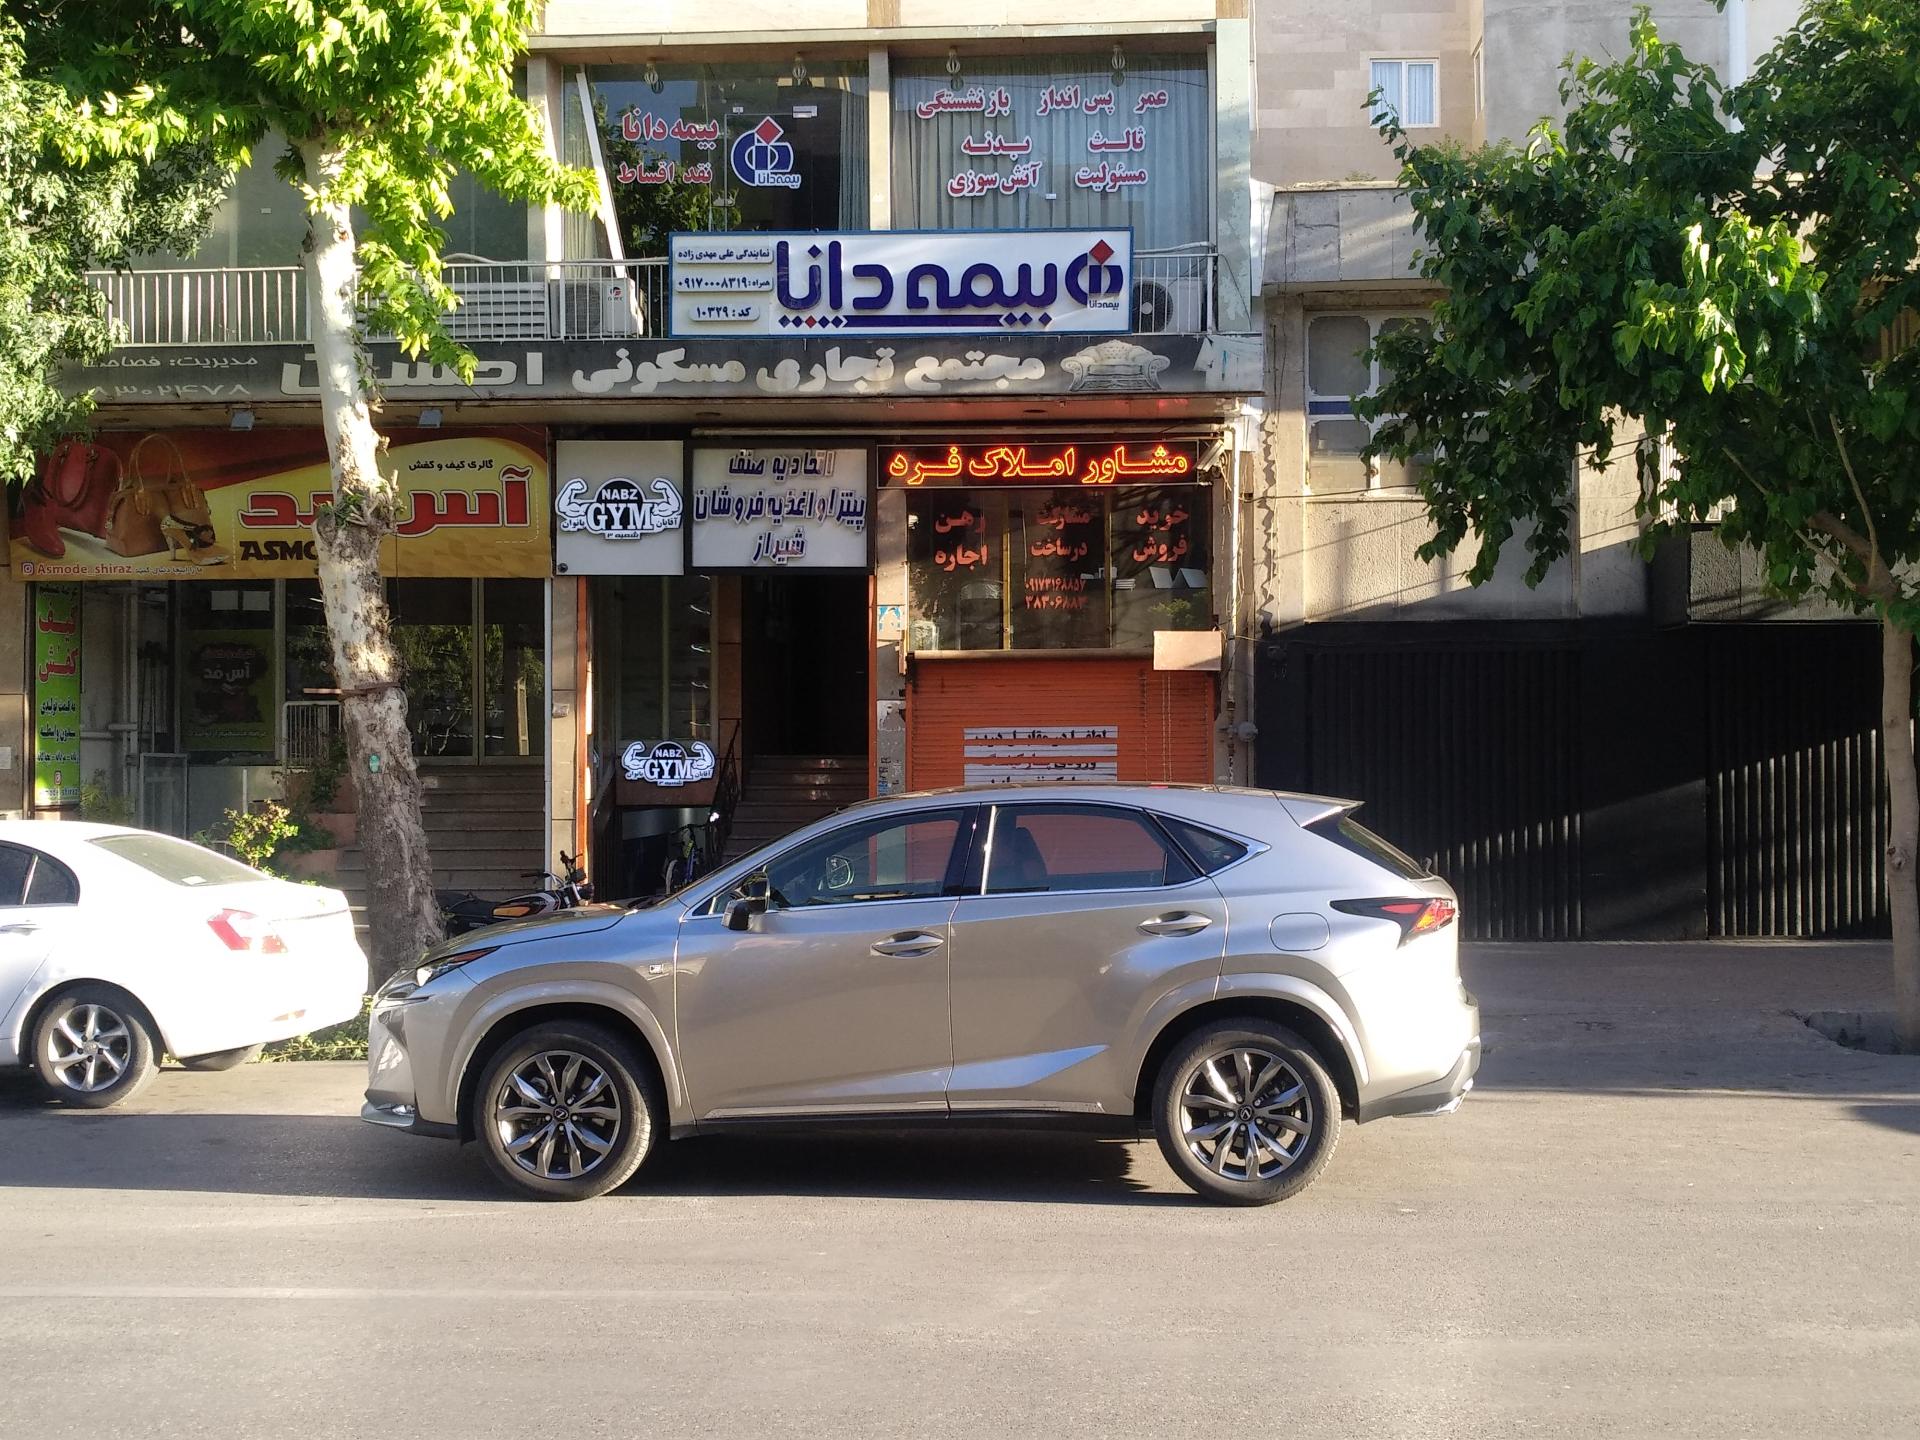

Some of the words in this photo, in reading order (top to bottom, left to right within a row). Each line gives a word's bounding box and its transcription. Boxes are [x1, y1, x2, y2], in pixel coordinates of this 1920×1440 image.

[1037, 85, 1079, 116] انداز
[1083, 89, 1114, 115] پس
[1134, 89, 1168, 113] عمر
[622, 108, 669, 141] دانا
[670, 119, 719, 150] بیمه
[1088, 125, 1145, 152] ثالث
[962, 130, 1032, 160] بدنه
[617, 160, 675, 184] اقساط
[683, 162, 713, 184] نقد
[948, 169, 998, 197] سوزی
[1001, 161, 1041, 193] آتش
[1075, 161, 1148, 192] مسئولیت
[678, 250, 694, 260] زاده
[696, 250, 717, 260] مهدی
[718, 249, 734, 260] علی
[736, 248, 770, 260] نمایندگی
[776, 240, 894, 311] دانا
[907, 262, 1058, 328] بیمه
[572, 347, 746, 393] مسکونی
[757, 346, 895, 393] تجاری
[903, 350, 1046, 392] مجتمع
[408, 460, 435, 471] کفش
[437, 463, 443, 471] و
[445, 460, 466, 470] کیف
[467, 459, 494, 471] گالری
[728, 450, 765, 475] صنف
[772, 450, 836, 481] اتحادیه
[889, 446, 963, 485] فرد
[968, 446, 1075, 477] املاک
[1082, 446, 1188, 484] مشاور
[601, 489, 639, 500] NABZ
[694, 486, 765, 522] فروشان
[767, 491, 815, 524] اغذیه
[586, 502, 654, 531] GYM
[816, 498, 826, 522] و
[828, 488, 866, 531] پیتزا
[935, 510, 986, 534] رهن
[1136, 504, 1189, 531] خرید
[239, 541, 319, 561] ASMO
[752, 528, 806, 564] شیراز
[935, 544, 988, 571] اجاره
[1133, 534, 1187, 562] فروش
[38, 602, 77, 642] کیف
[38, 645, 79, 683] کفش
[655, 749, 683, 758] NABZ
[644, 759, 693, 780] GYM
